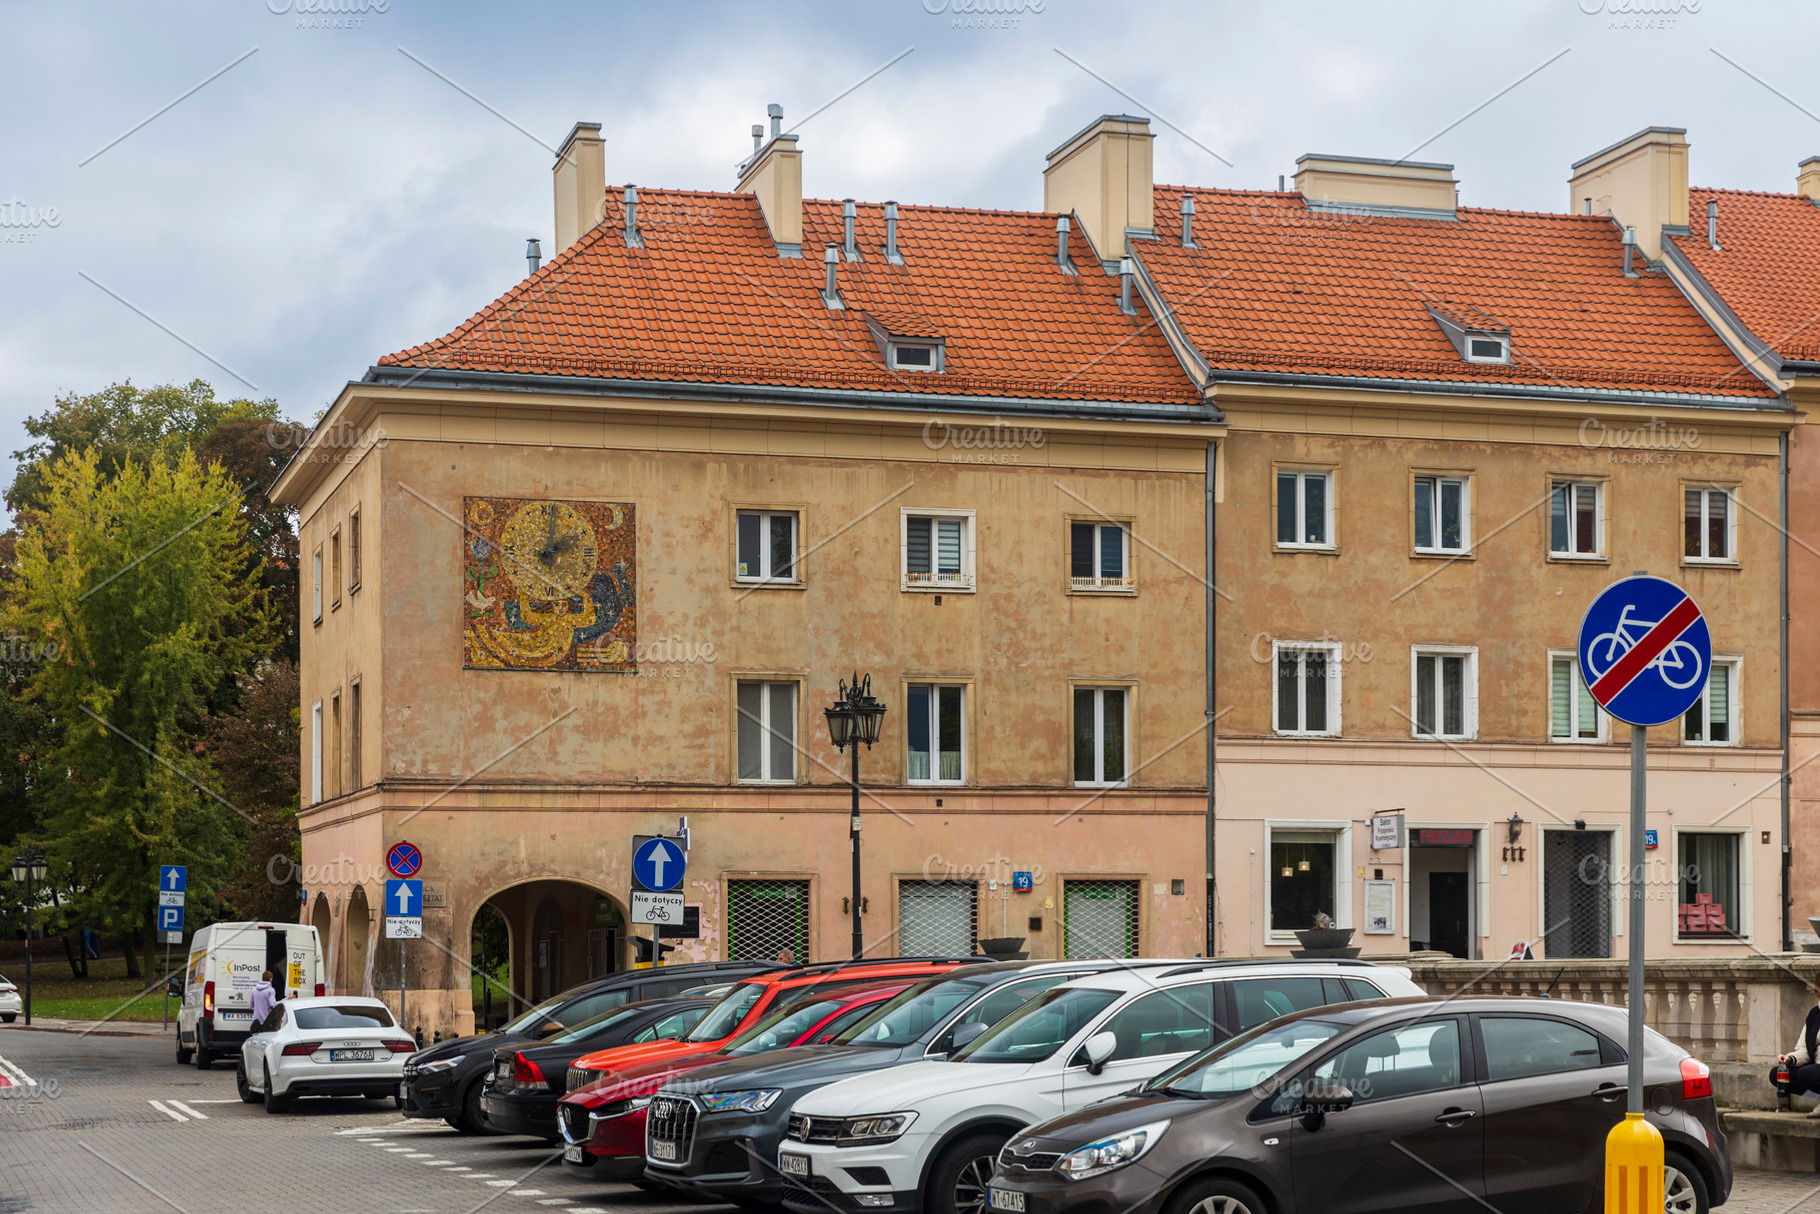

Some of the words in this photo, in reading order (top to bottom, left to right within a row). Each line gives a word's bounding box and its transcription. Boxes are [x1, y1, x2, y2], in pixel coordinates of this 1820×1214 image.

[1420, 830, 1472, 844] FRYZJER
[1018, 876, 1028, 887] 19
[652, 896, 682, 905] dotyczy
[164, 909, 178, 928] P
